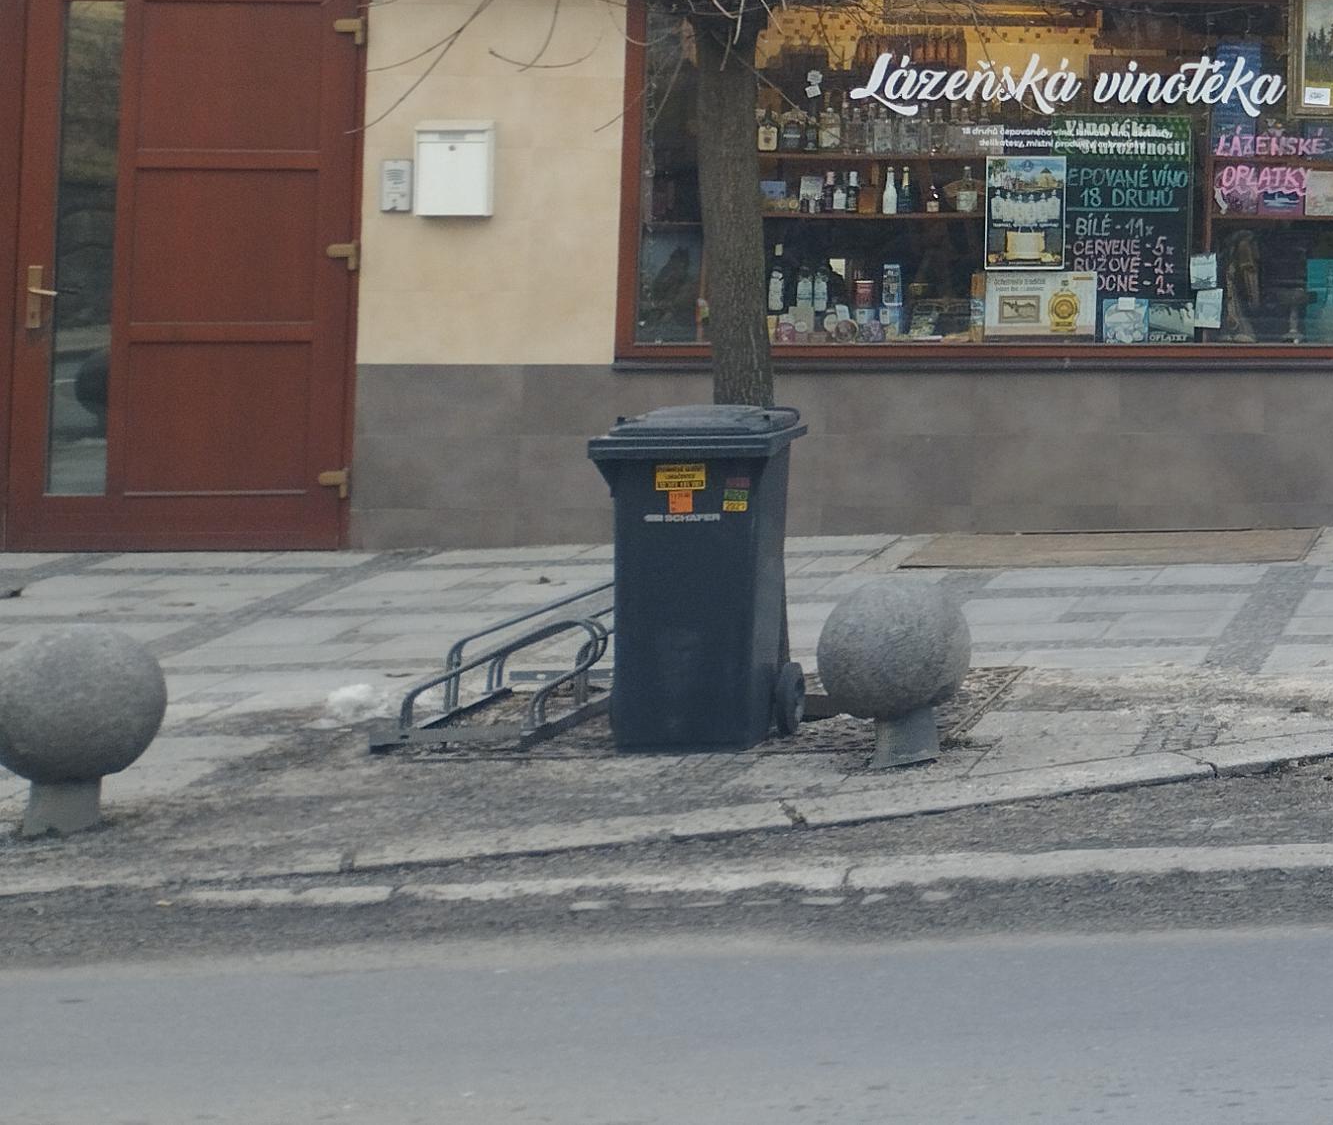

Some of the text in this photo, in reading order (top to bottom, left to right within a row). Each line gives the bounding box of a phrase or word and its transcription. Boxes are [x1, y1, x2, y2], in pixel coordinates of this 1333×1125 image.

[850, 52, 1286, 118] Lázeňská vinotéka
[1067, 164, 1189, 188] EPOVANÉ VÍNO
[1080, 187, 1102, 207] 18
[1075, 213, 1113, 236] BÍLÉ
